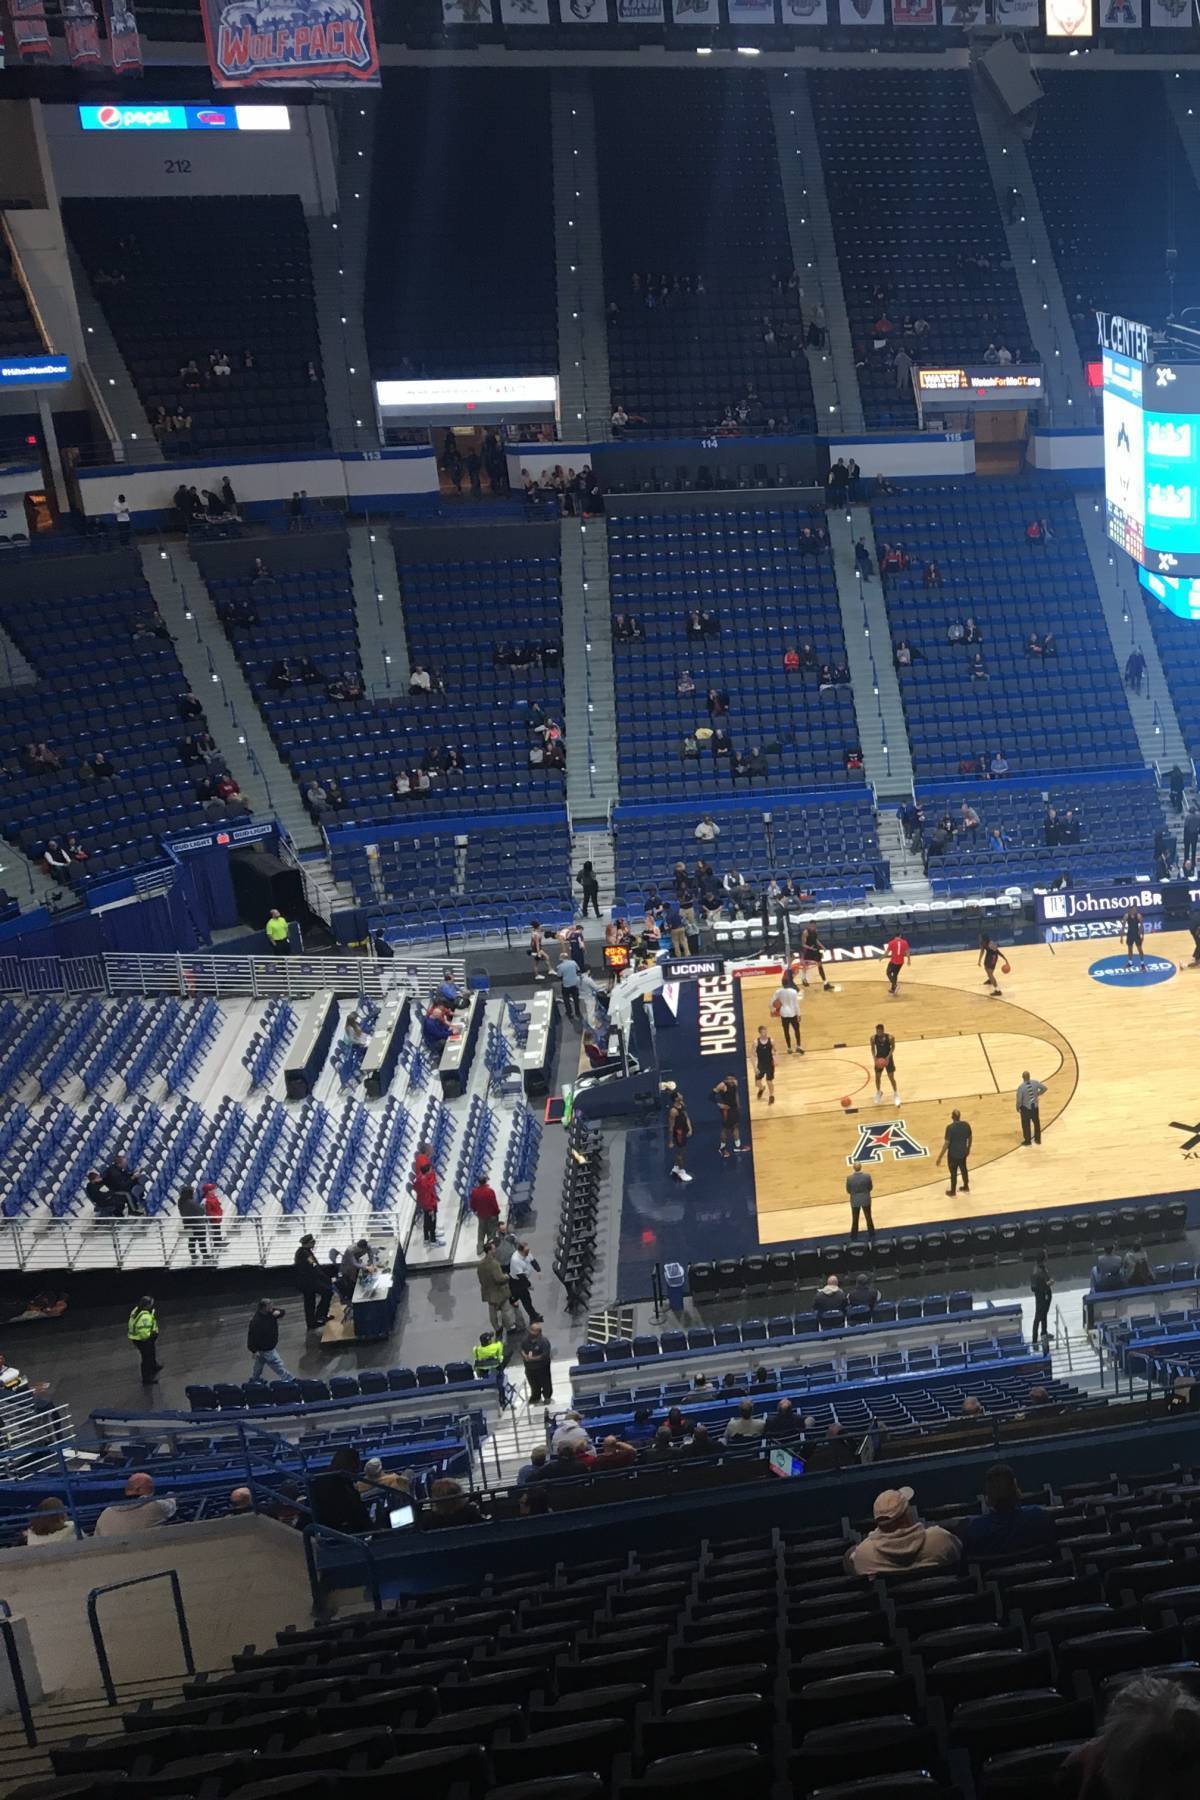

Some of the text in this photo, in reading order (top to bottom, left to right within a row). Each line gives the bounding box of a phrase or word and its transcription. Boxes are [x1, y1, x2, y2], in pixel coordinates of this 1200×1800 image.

[293, 19, 363, 59] PACK
[123, 109, 172, 126] pepsi
[164, 159, 192, 173] 212
[1096, 311, 1149, 363] XL CENTER
[702, 440, 718, 448] 114
[945, 433, 961, 441] 115
[362, 451, 381, 460] 113
[174, 825, 271, 851] BUD LIGHT BUD LIGHT
[671, 963, 715, 975] UCONN
[698, 974, 737, 1056] HUSKIES
